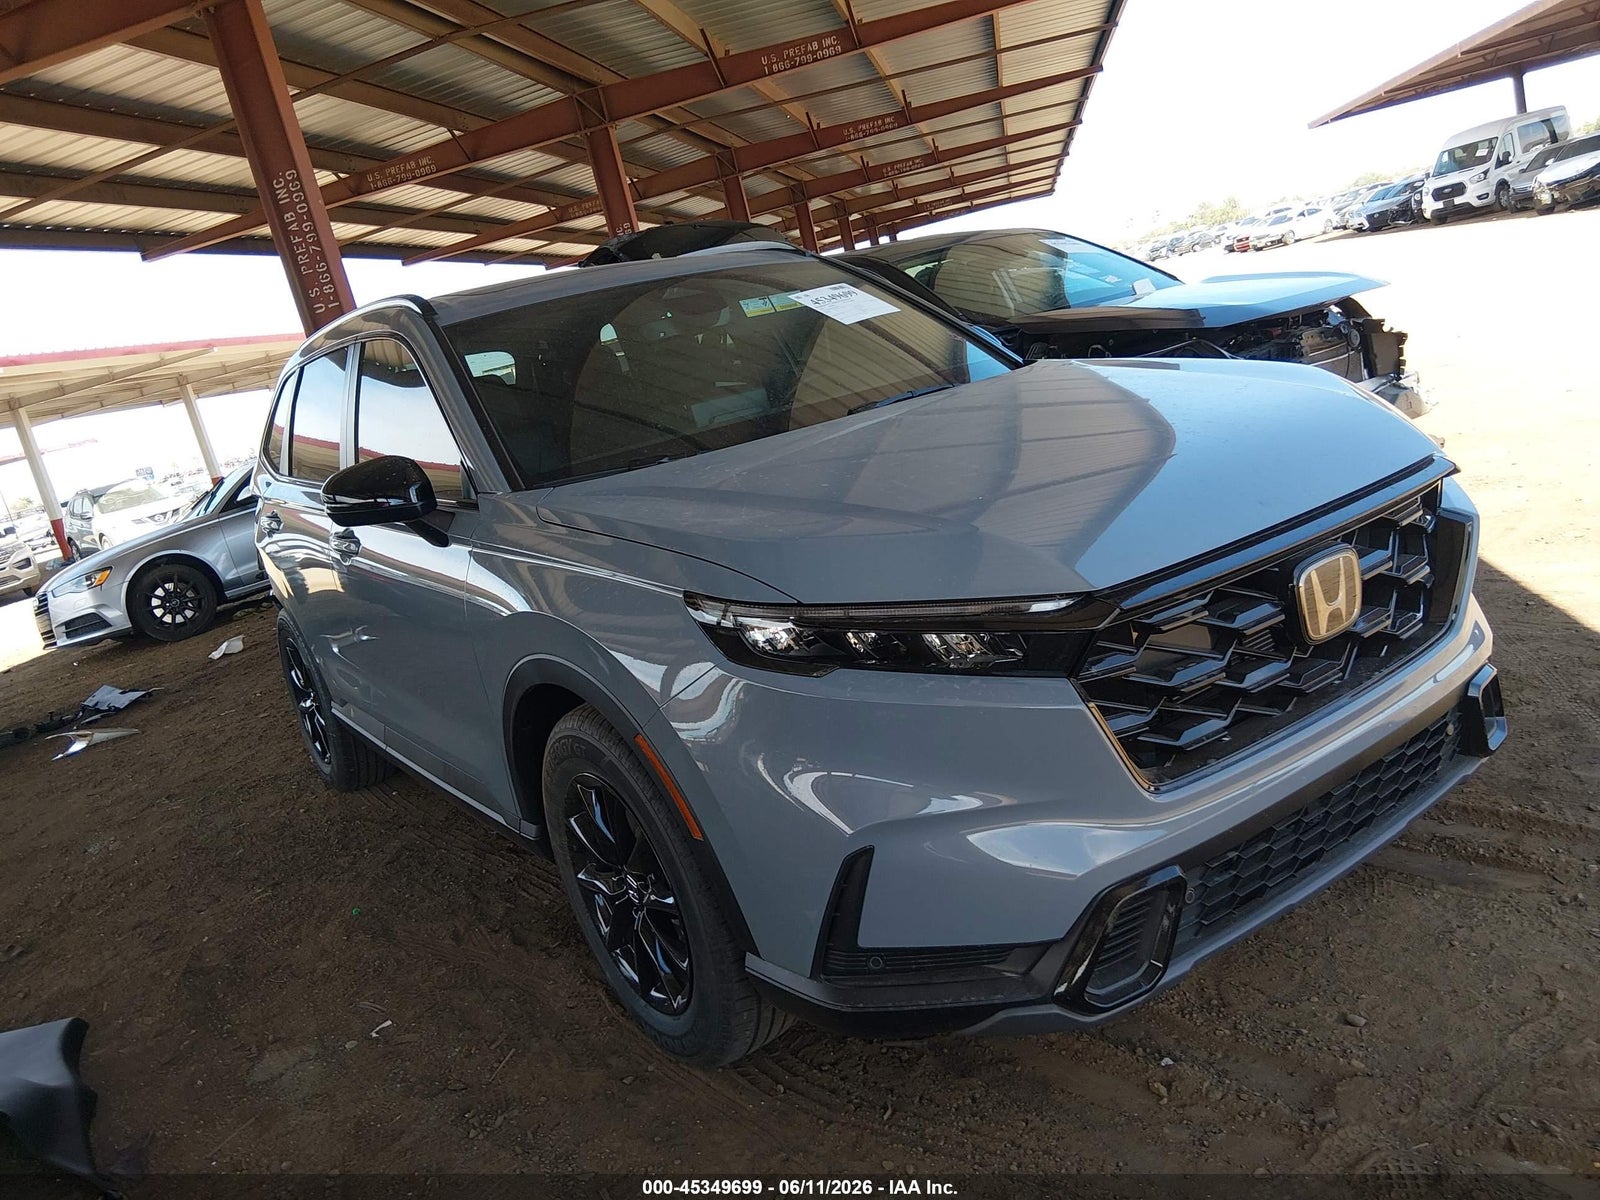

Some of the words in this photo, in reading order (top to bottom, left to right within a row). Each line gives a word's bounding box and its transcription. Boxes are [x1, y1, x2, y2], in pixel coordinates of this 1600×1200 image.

[761, 53, 780, 65] U.S.
[783, 41, 819, 59] PREFAB
[822, 35, 841, 48] INC.
[366, 171, 383, 182] U.S.
[385, 160, 417, 177] PREFAB
[418, 155, 435, 166] INC.
[369, 164, 437, 190] 1-866-799-0969
[272, 171, 290, 205] INC.
[283, 211, 314, 275] PREFAB
[285, 169, 340, 309] 1-866-799-0969
[309, 281, 326, 314] U.S.
